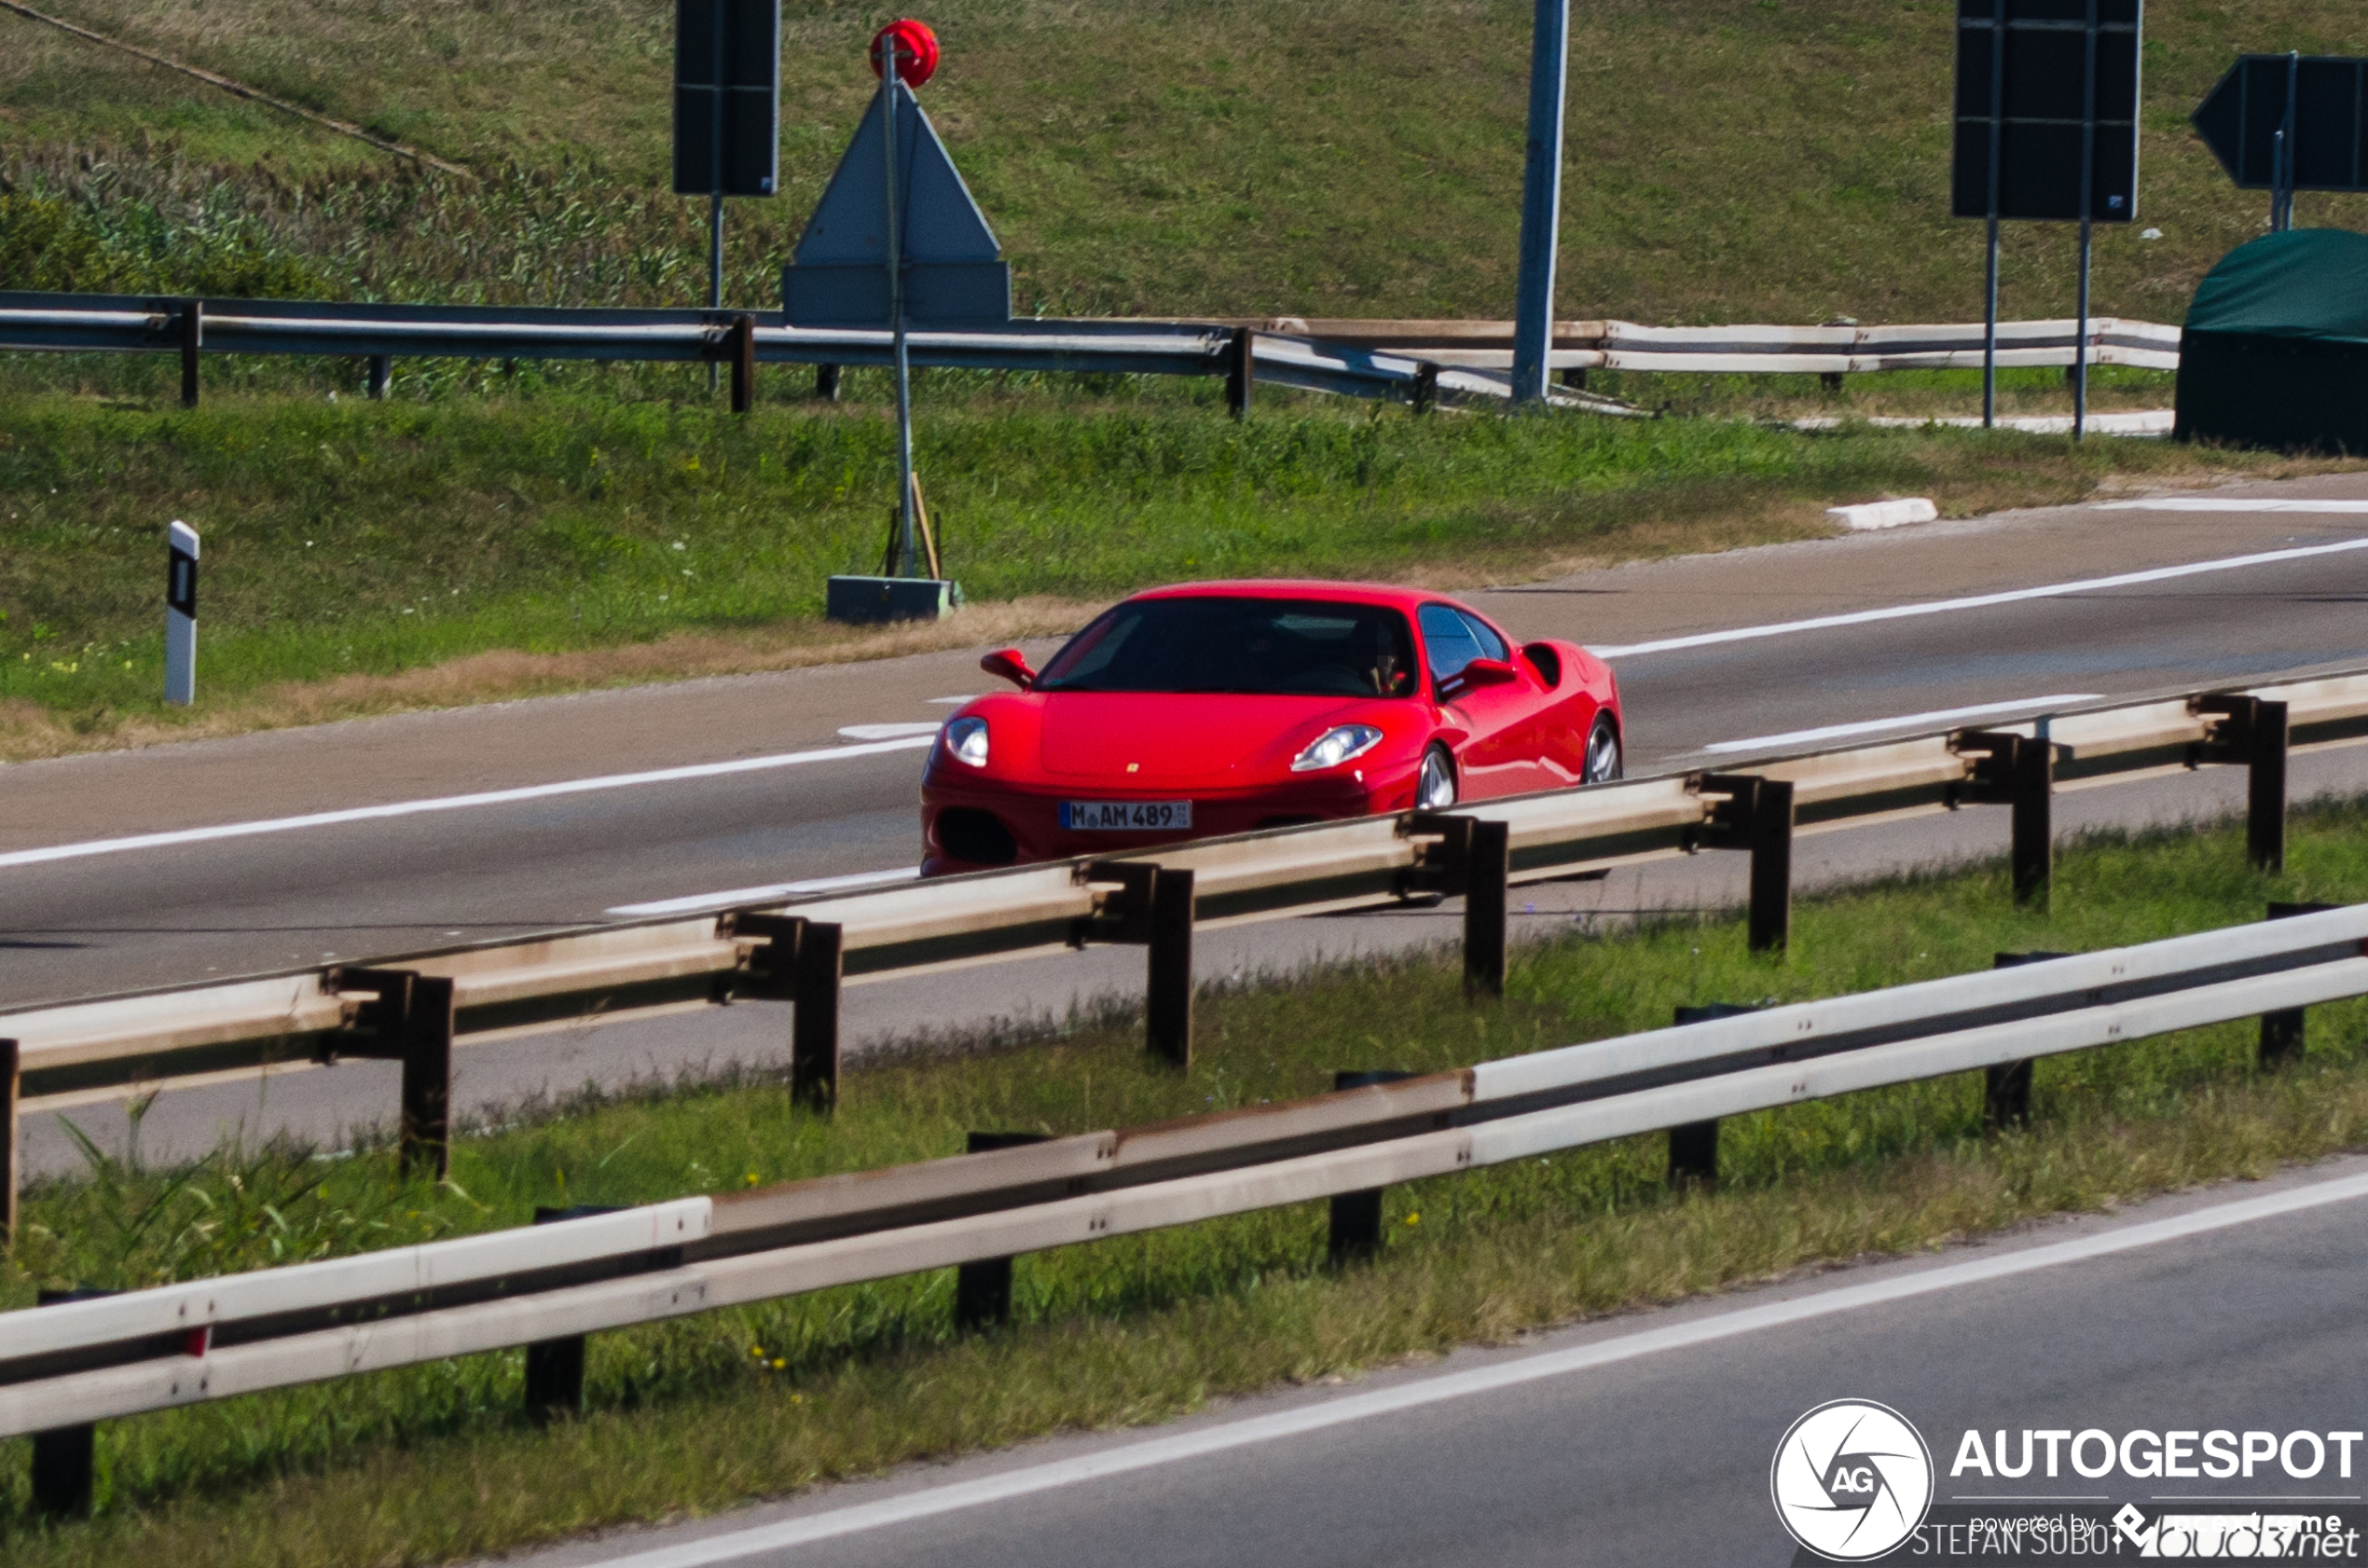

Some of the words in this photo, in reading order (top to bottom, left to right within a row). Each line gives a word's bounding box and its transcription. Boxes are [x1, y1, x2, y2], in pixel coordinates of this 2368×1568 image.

[1071, 804, 1086, 827] M
[1100, 805, 1128, 827] AM
[1132, 805, 1174, 827] 489
